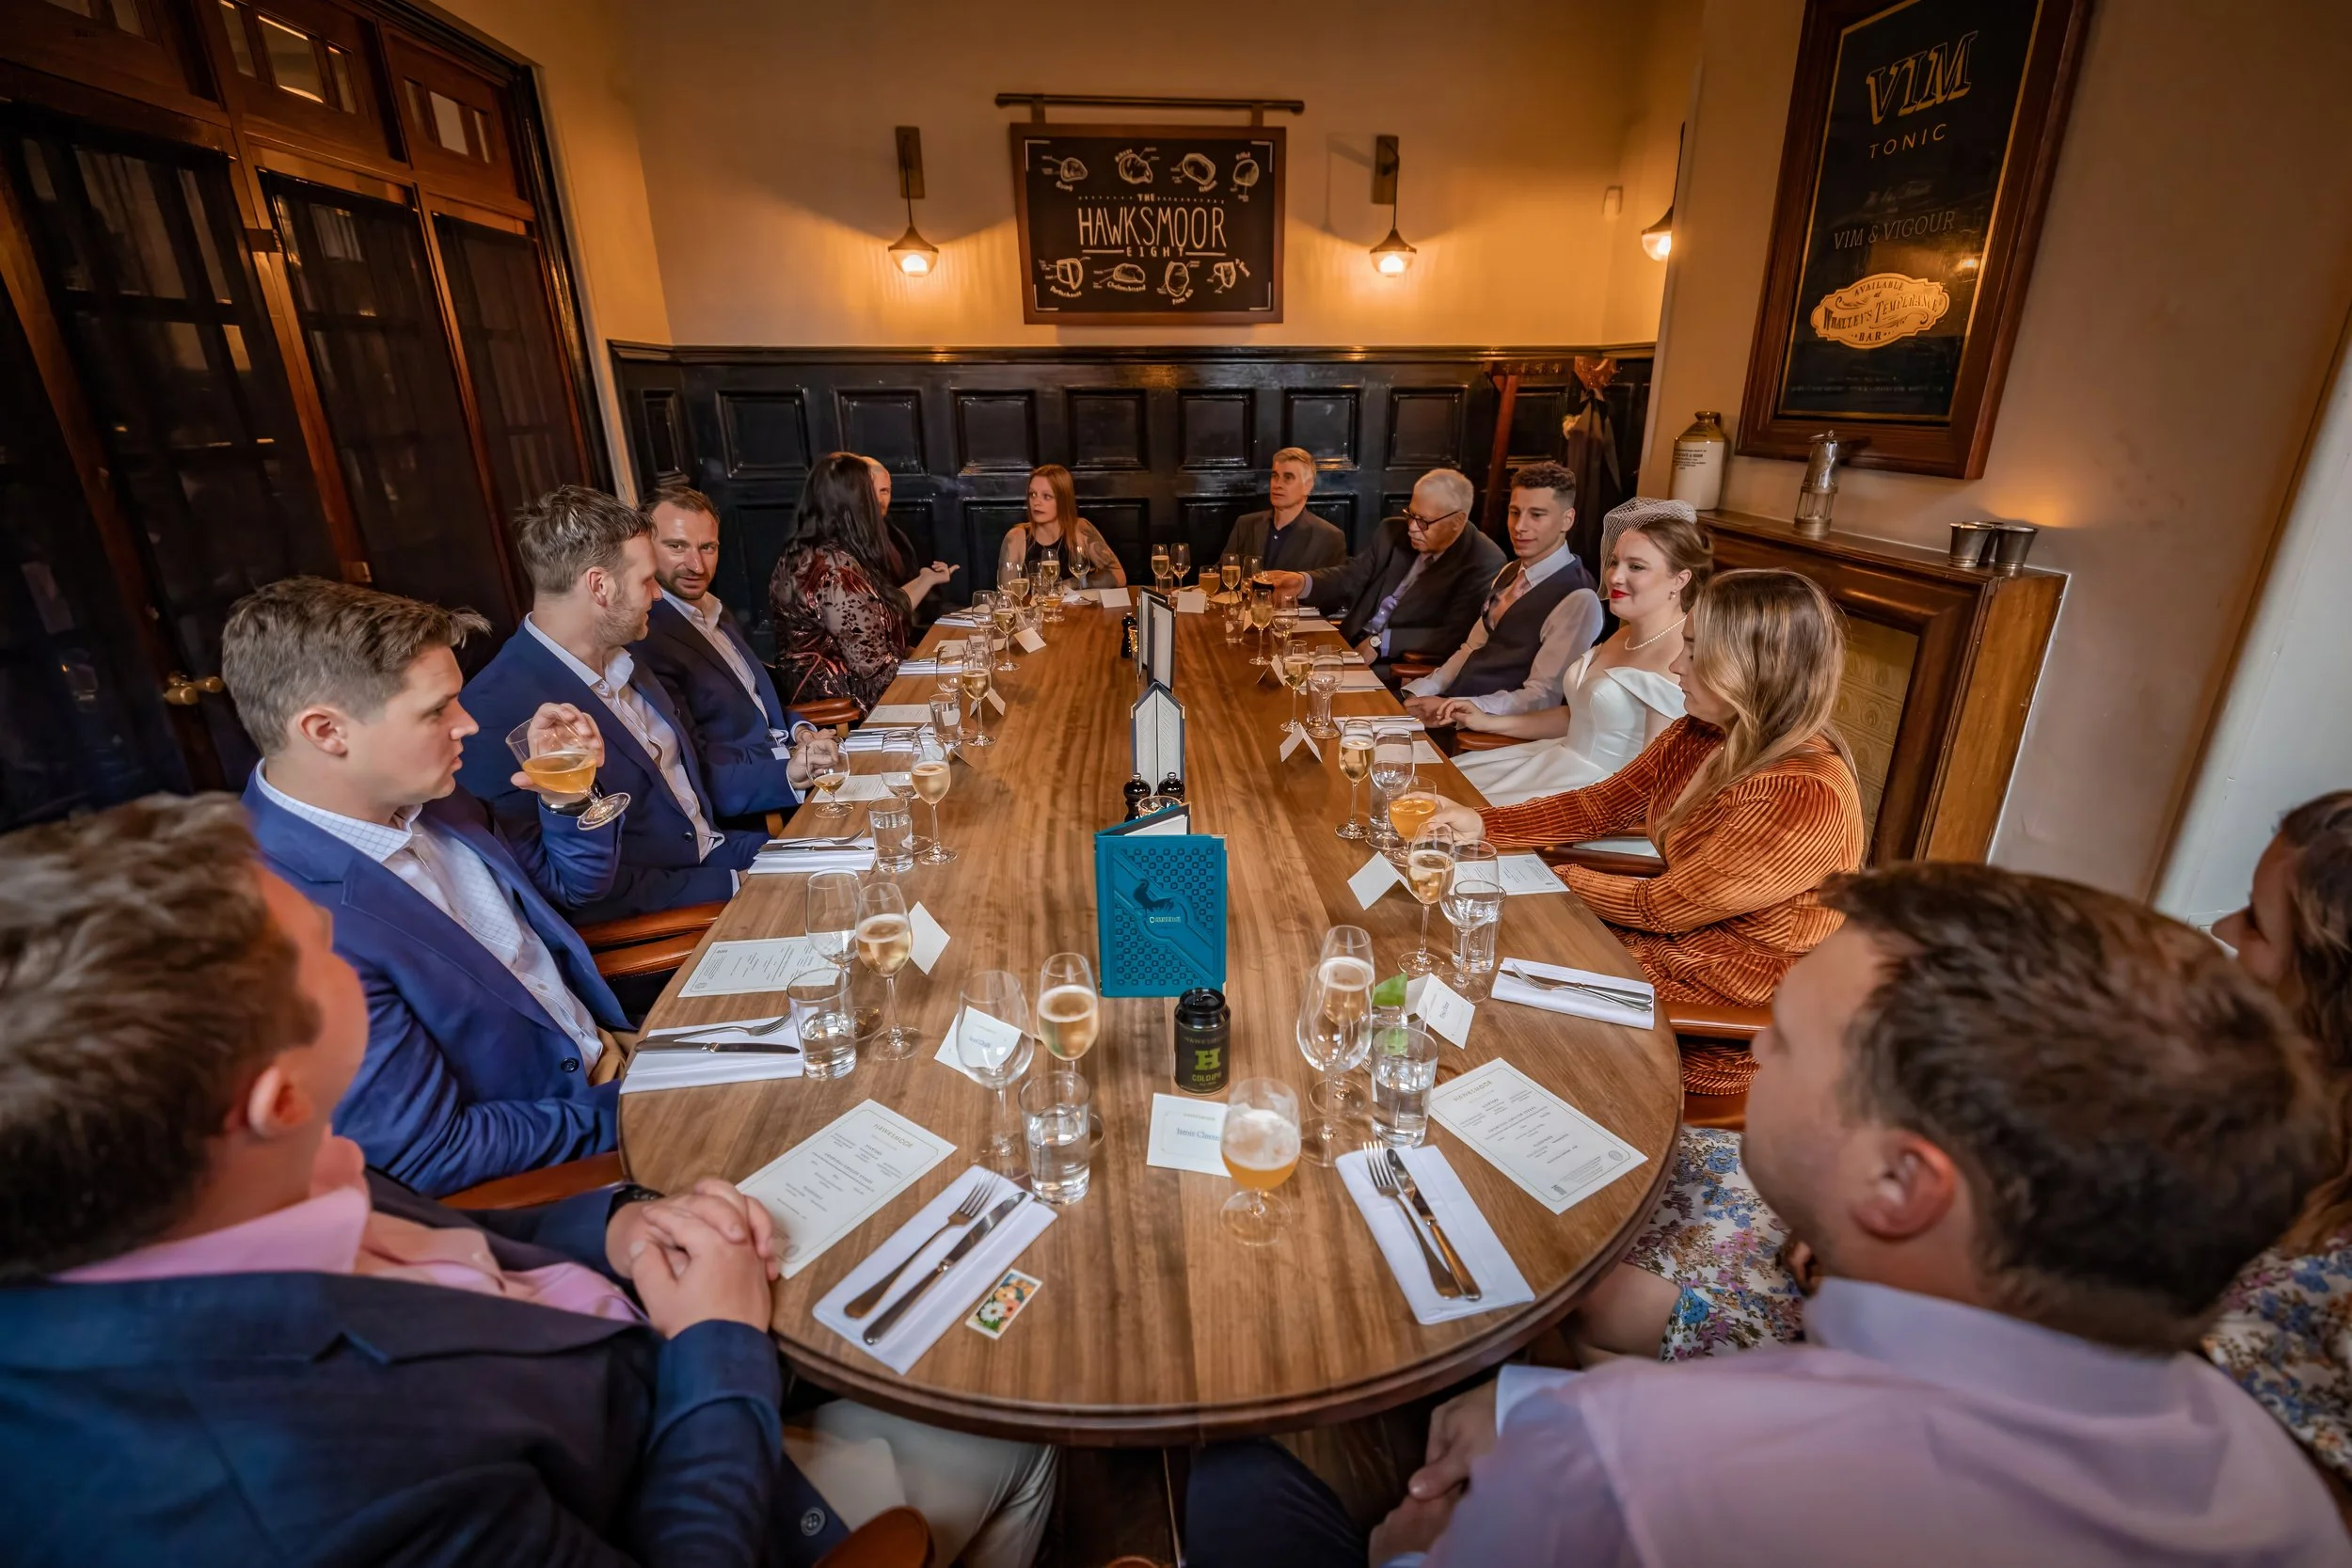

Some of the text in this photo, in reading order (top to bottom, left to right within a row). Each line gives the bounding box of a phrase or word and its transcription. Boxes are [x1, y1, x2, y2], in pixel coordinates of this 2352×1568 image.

[1866, 30, 1979, 124] VIM
[1869, 123, 1947, 159] TONIC
[1137, 193, 1155, 202] THE
[1078, 206, 1227, 248] HAWKSMOOR
[1834, 211, 1956, 249] VIM & VIGOUR
[1126, 246, 1184, 257] EIGHT
[1854, 281, 1903, 296] AVAILABLE
[1858, 331, 1882, 341] BAR
[1194, 1047, 1221, 1070] H
